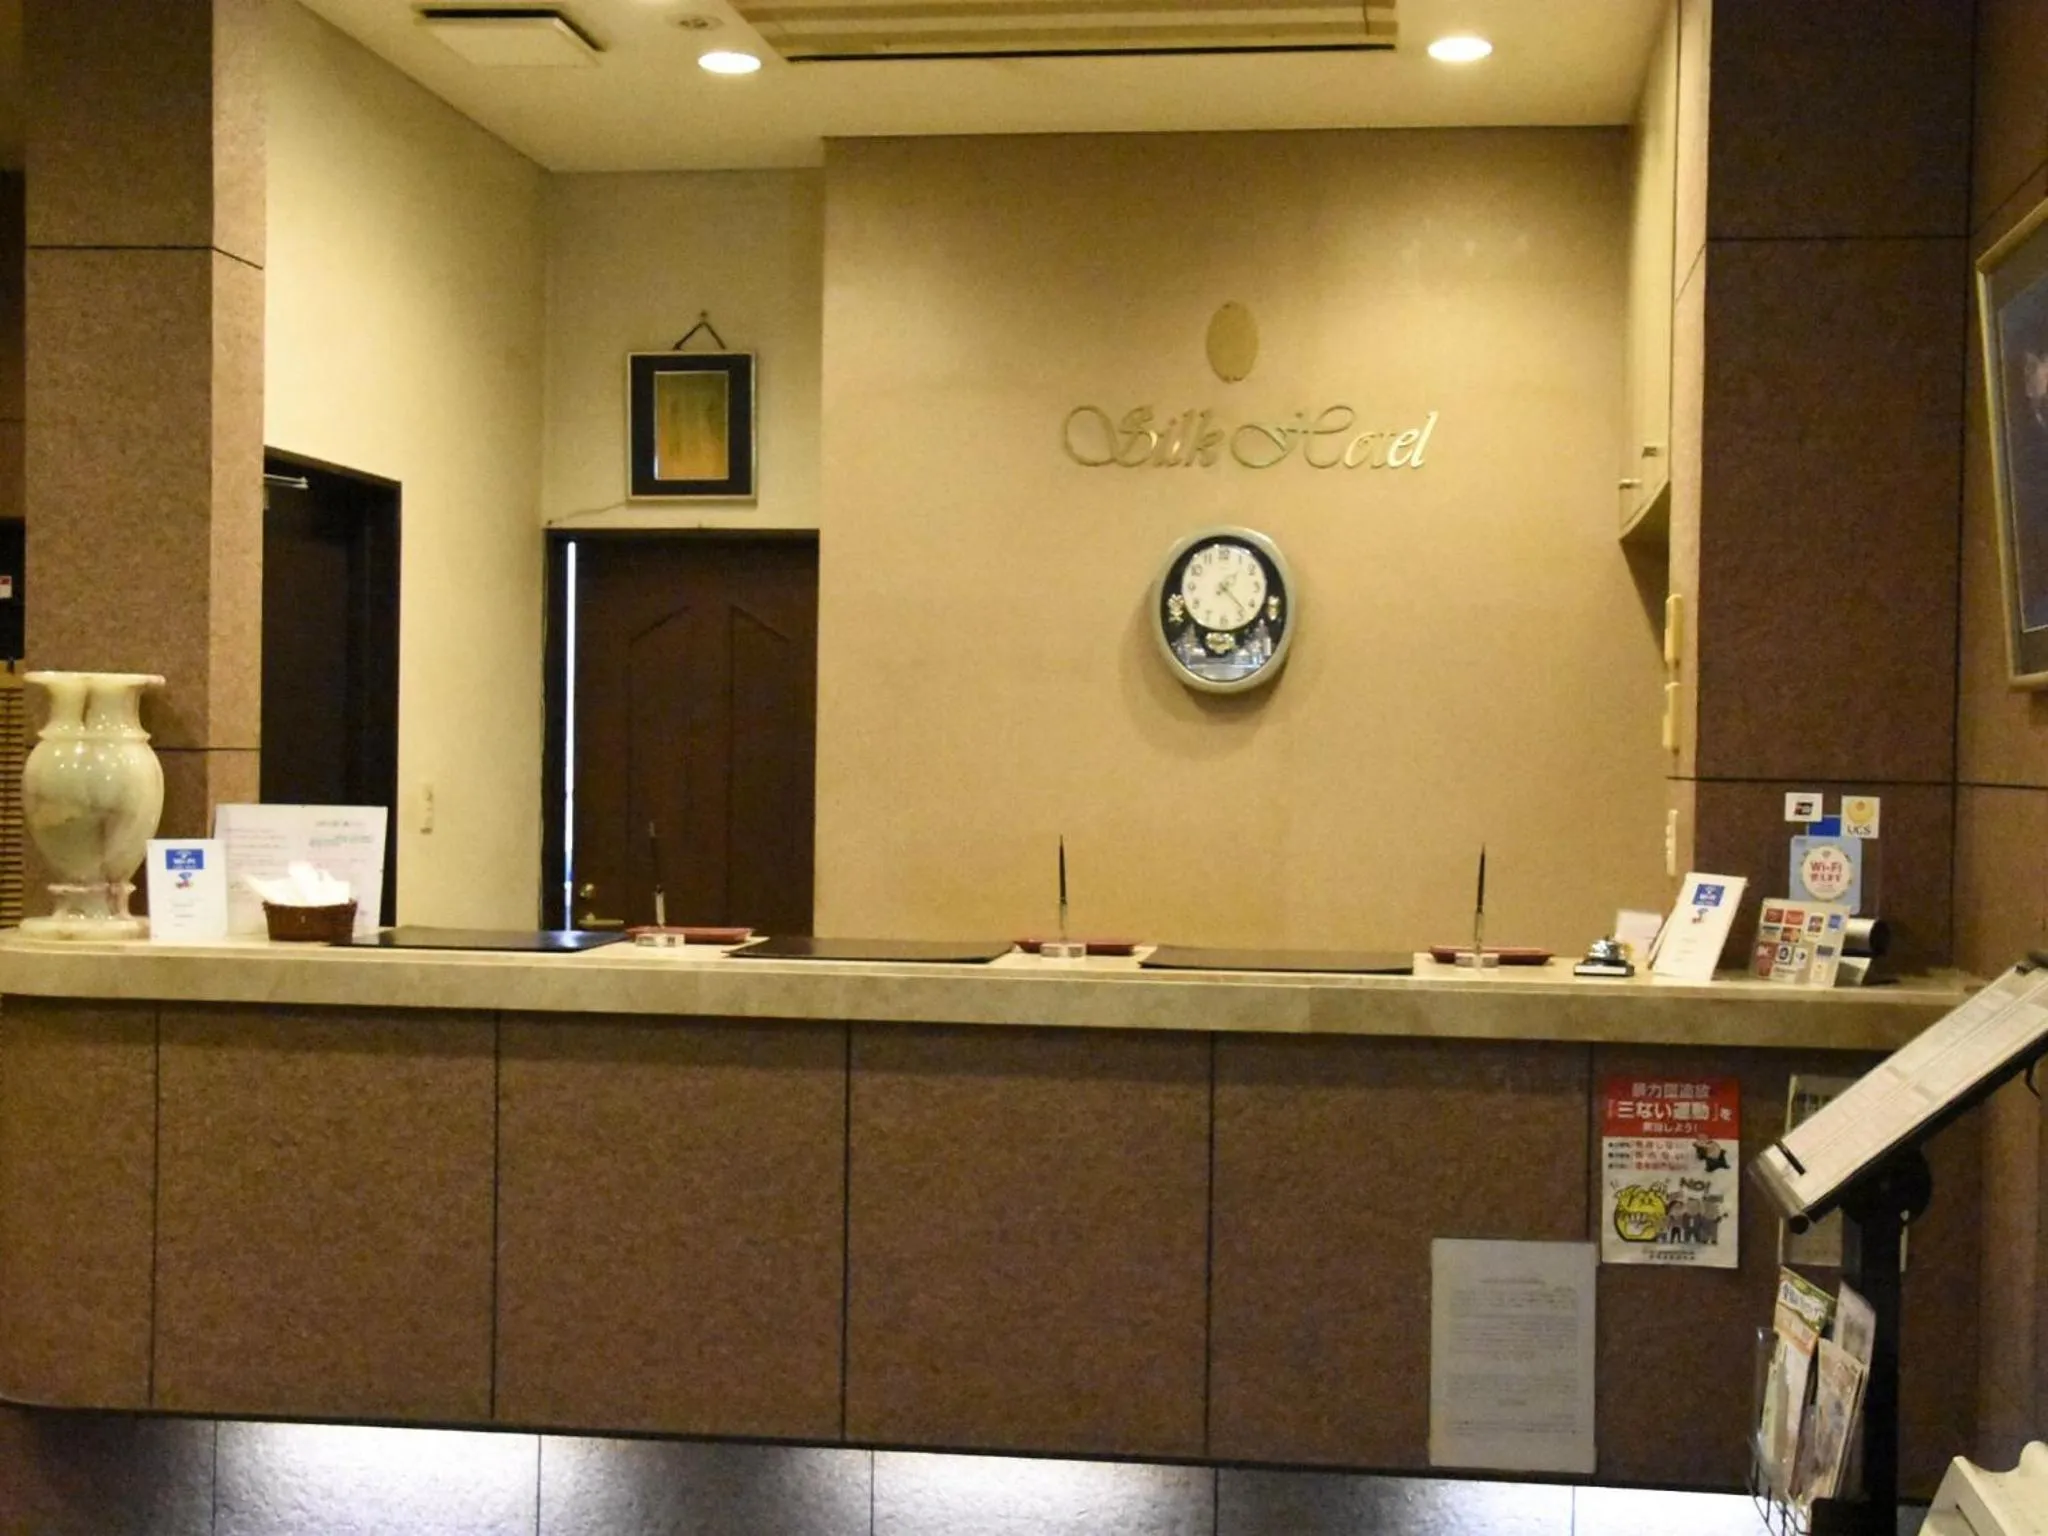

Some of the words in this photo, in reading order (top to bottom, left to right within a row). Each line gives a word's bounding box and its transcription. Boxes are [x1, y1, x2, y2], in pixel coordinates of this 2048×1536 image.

[1062, 405, 1226, 468] Silk
[1230, 405, 1438, 469] Hotel
[1810, 861, 1842, 873] Wi-Fi
